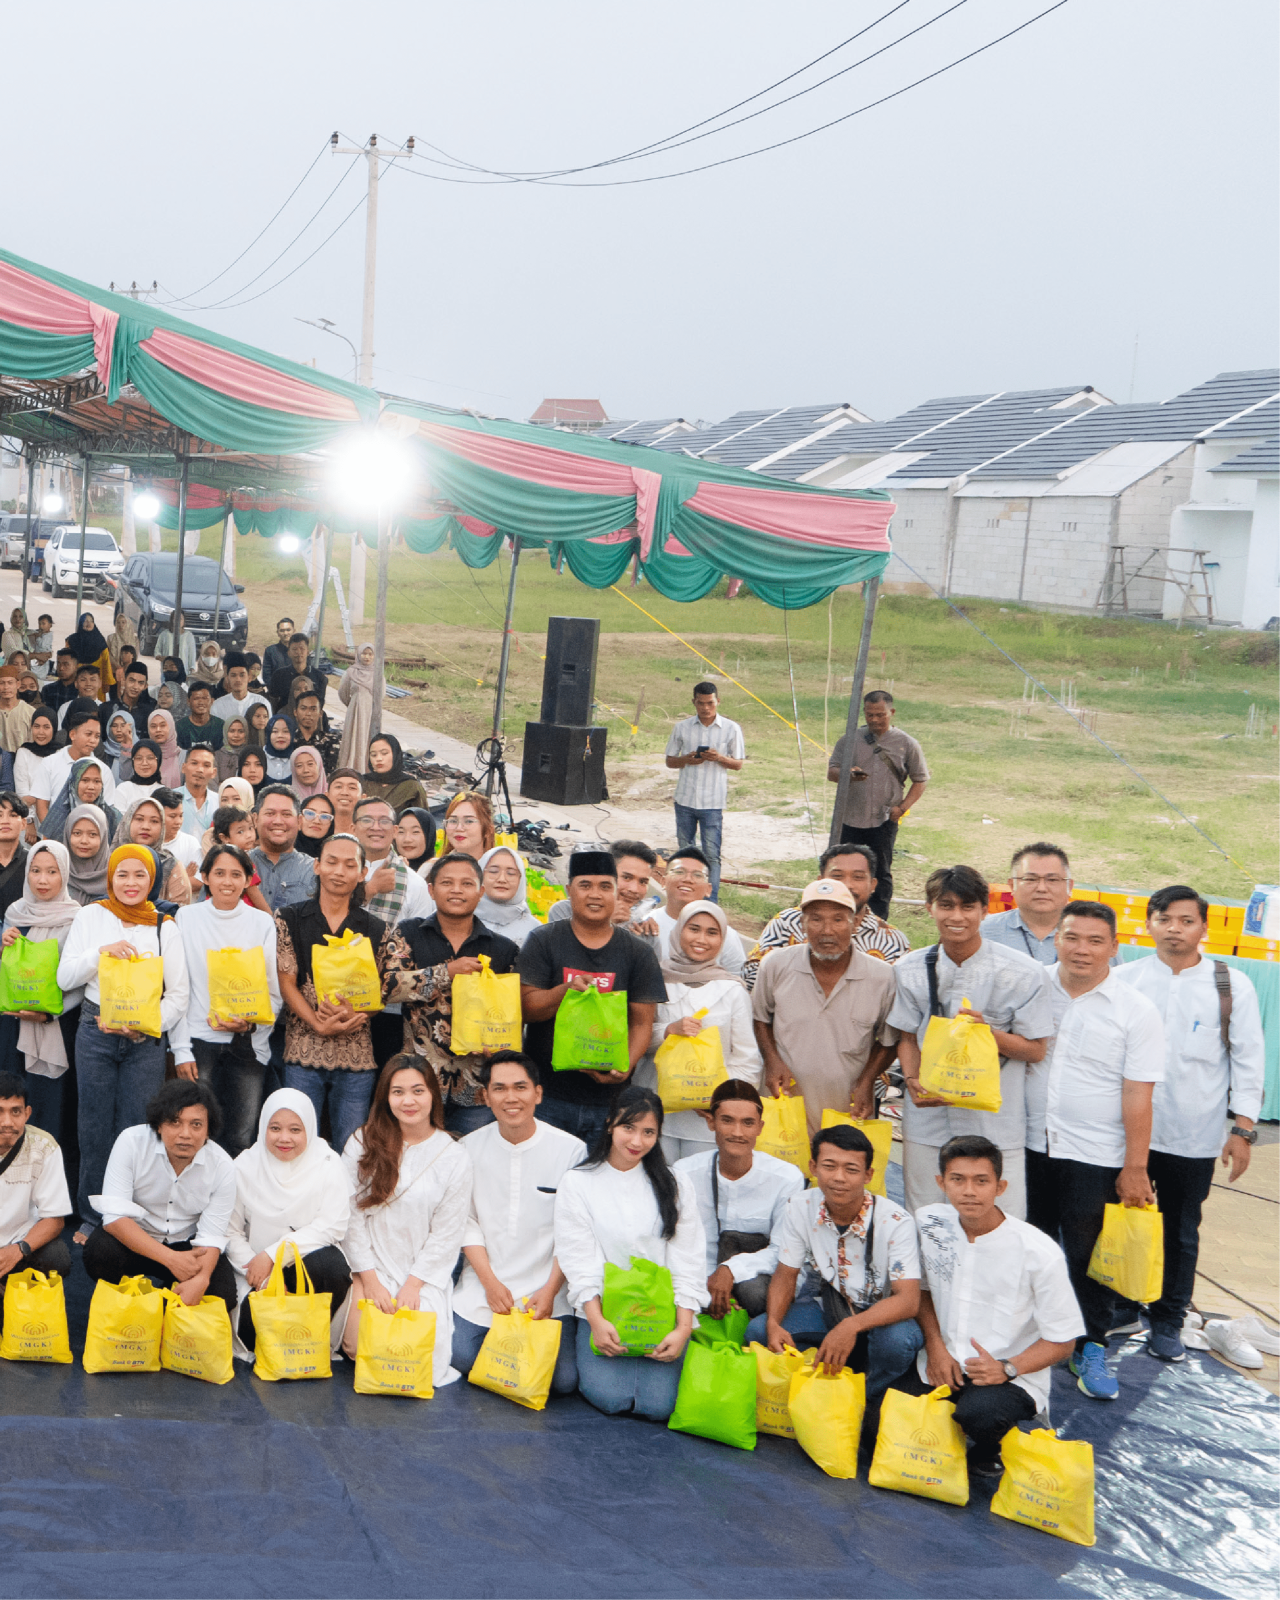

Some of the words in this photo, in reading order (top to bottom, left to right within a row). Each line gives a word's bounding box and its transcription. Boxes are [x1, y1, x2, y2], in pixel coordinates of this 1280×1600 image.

[400, 1383, 416, 1391] BTN
[925, 1476, 943, 1485] BTN
[1041, 1519, 1060, 1529] BTN
